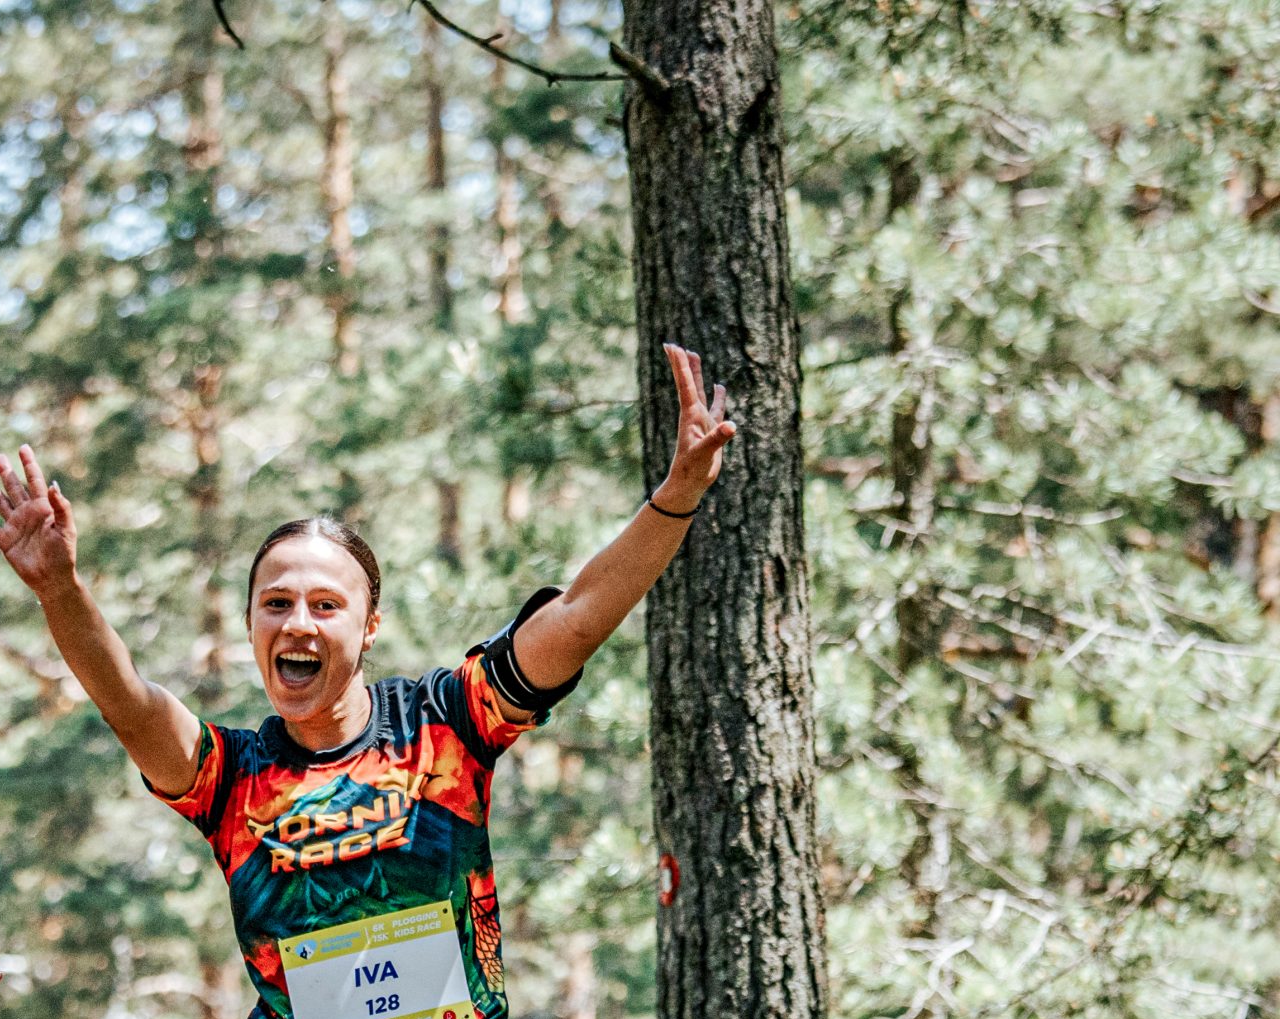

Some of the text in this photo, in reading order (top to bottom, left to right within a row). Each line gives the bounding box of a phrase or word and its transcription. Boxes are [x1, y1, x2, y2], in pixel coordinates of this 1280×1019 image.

[269, 817, 411, 874] RACE
[392, 911, 438, 928] PLOGGING
[373, 932, 389, 943] 15K
[394, 927, 415, 938] KIDS
[417, 920, 441, 933] RACE
[354, 960, 399, 988] IVA
[365, 994, 401, 1016] 128
